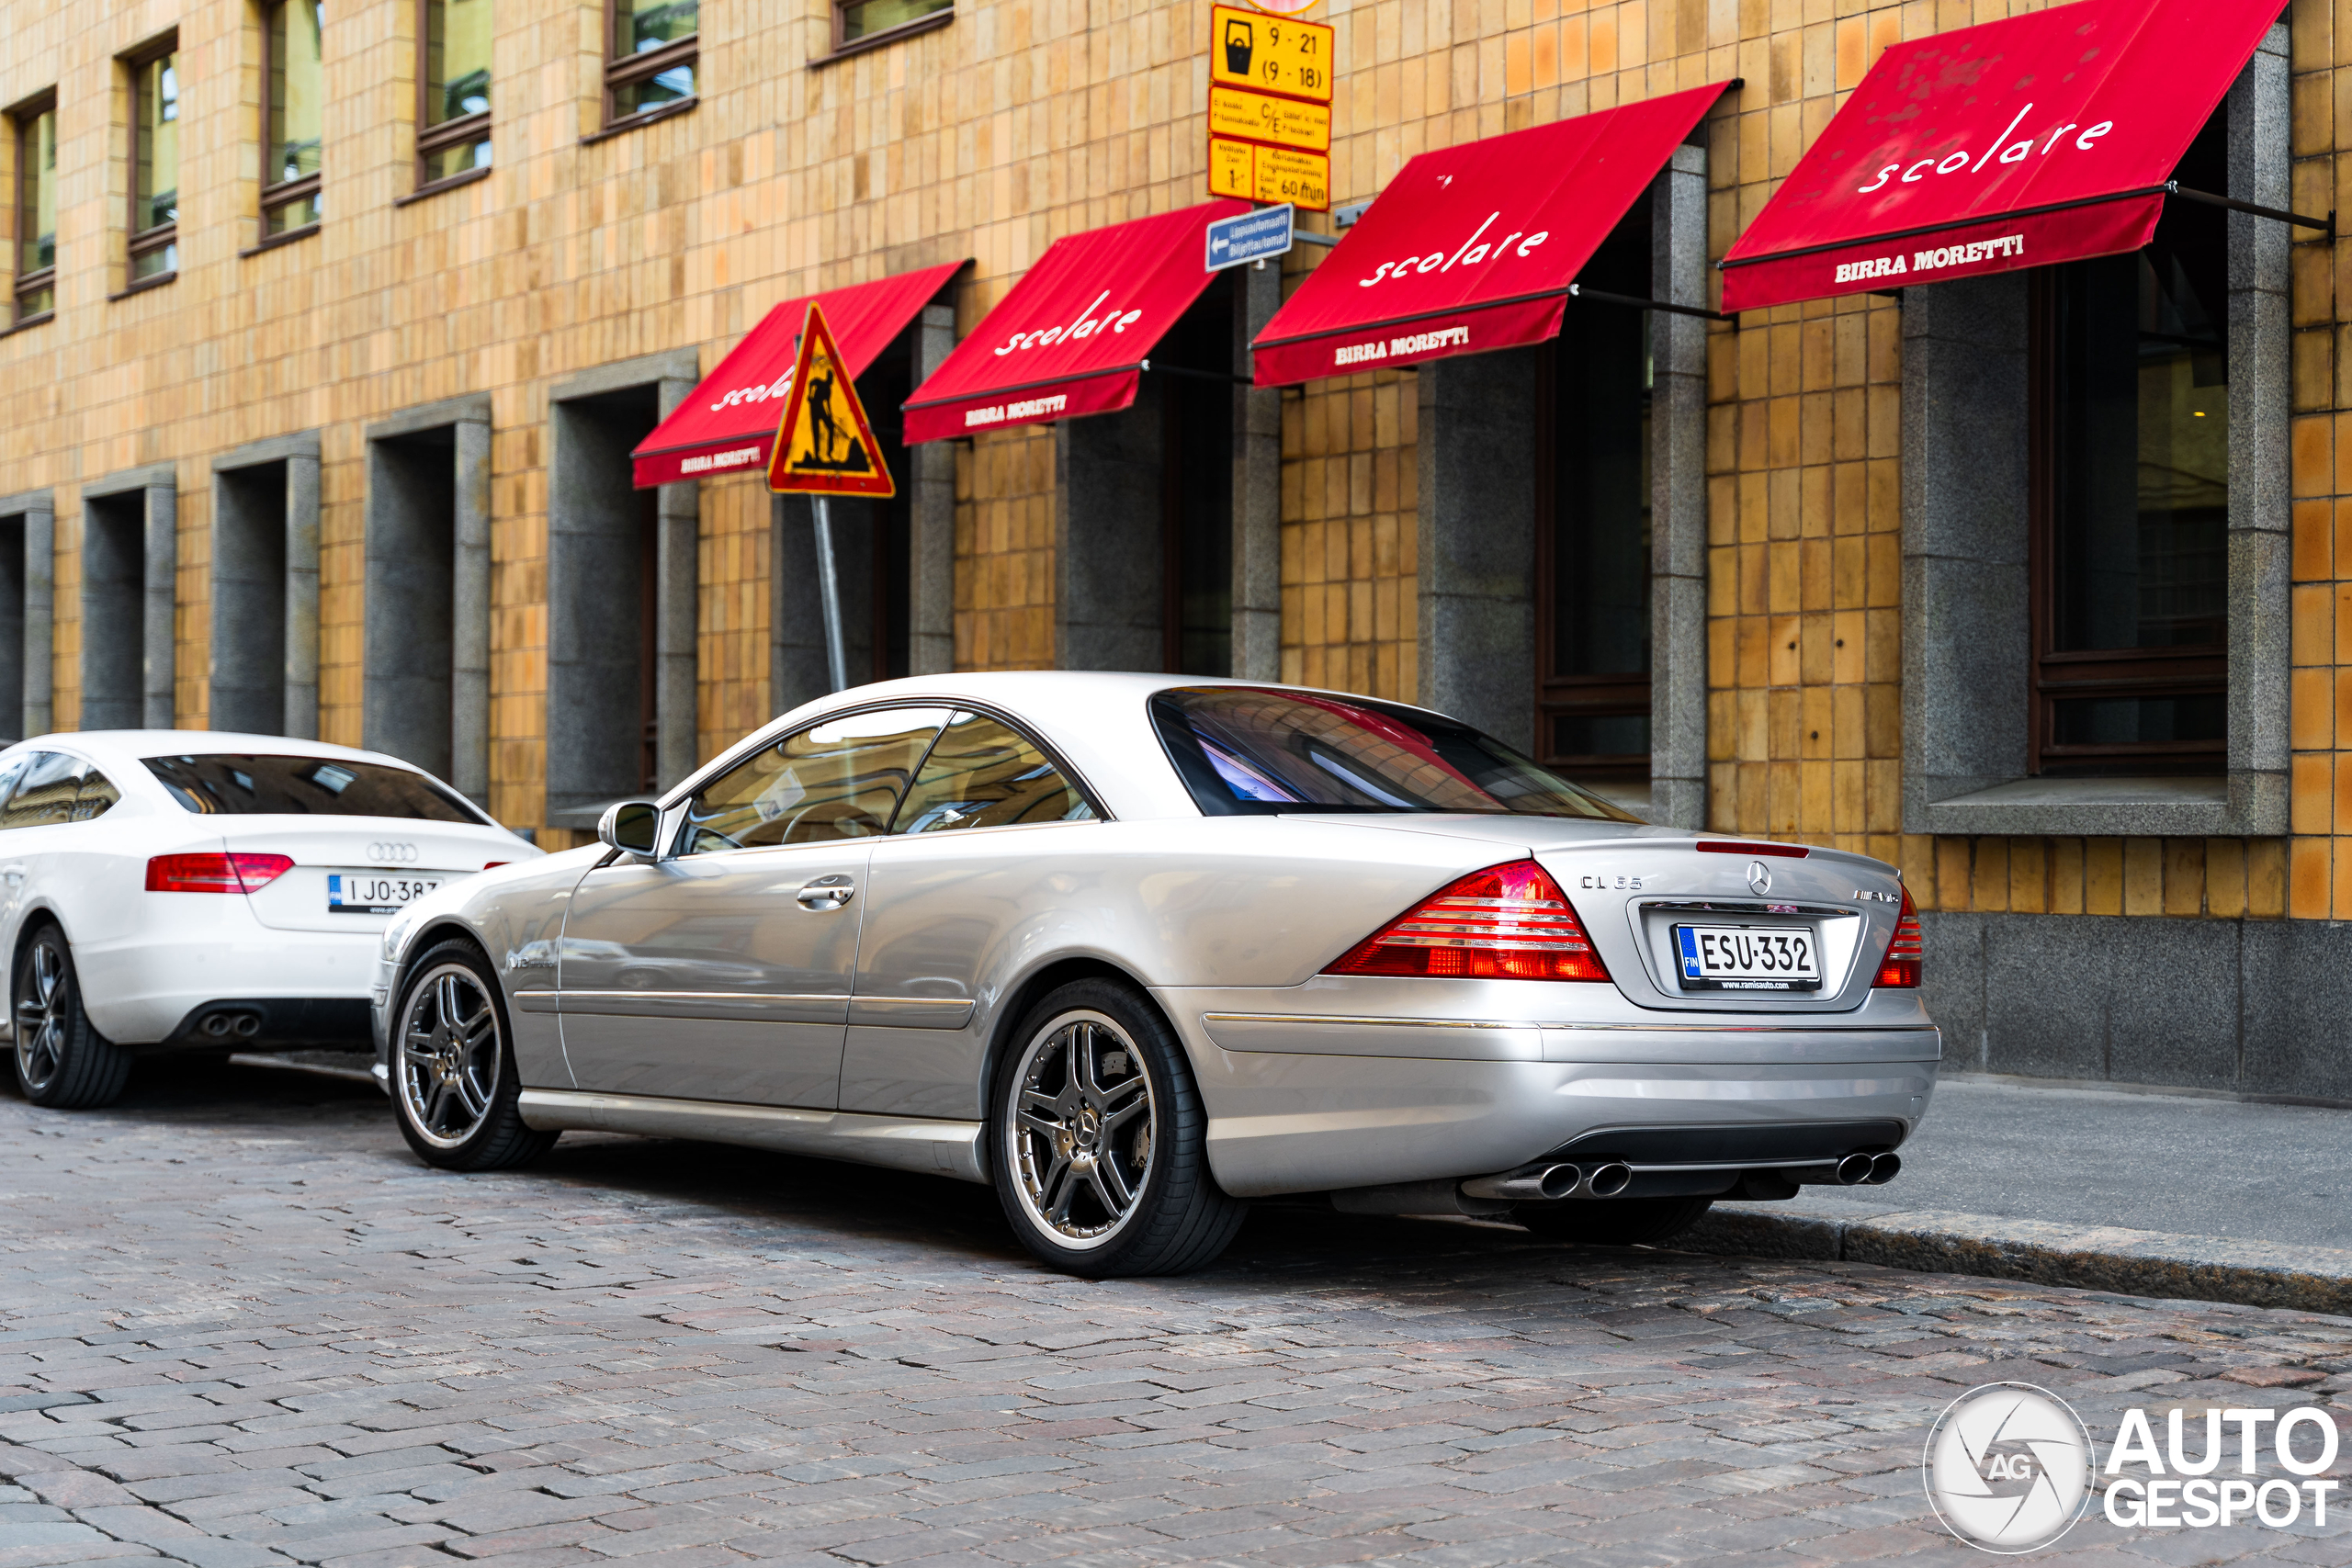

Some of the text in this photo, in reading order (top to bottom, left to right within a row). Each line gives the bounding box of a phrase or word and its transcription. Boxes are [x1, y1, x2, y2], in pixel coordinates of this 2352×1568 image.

[1270, 28, 1279, 47] 9
[1300, 33, 1317, 54] 21
[1262, 60, 1279, 81] (9
[1299, 66, 1322, 89] 18)
[1858, 102, 2113, 194] scolare
[1229, 168, 1235, 188] 1
[1282, 179, 1325, 199] 60 min
[1229, 211, 1288, 240] Lippuautomaatti
[1228, 231, 1287, 257] Biljettautomat
[1359, 210, 1549, 288] scolare
[1835, 234, 2024, 284] BIRRA MORETTI
[994, 289, 1142, 356] scolare
[1335, 325, 1469, 367] BIRRA MORETTI
[710, 364, 794, 412] scola
[965, 394, 1068, 427] BIRRA MORETTI
[681, 446, 761, 474] BIRRA MORETTI
[1580, 875, 1643, 890] CL 65
[1684, 956, 1699, 968] FIN
[1700, 934, 1811, 972] ESU-332
[1721, 980, 1790, 989] www.ramisauto.com
